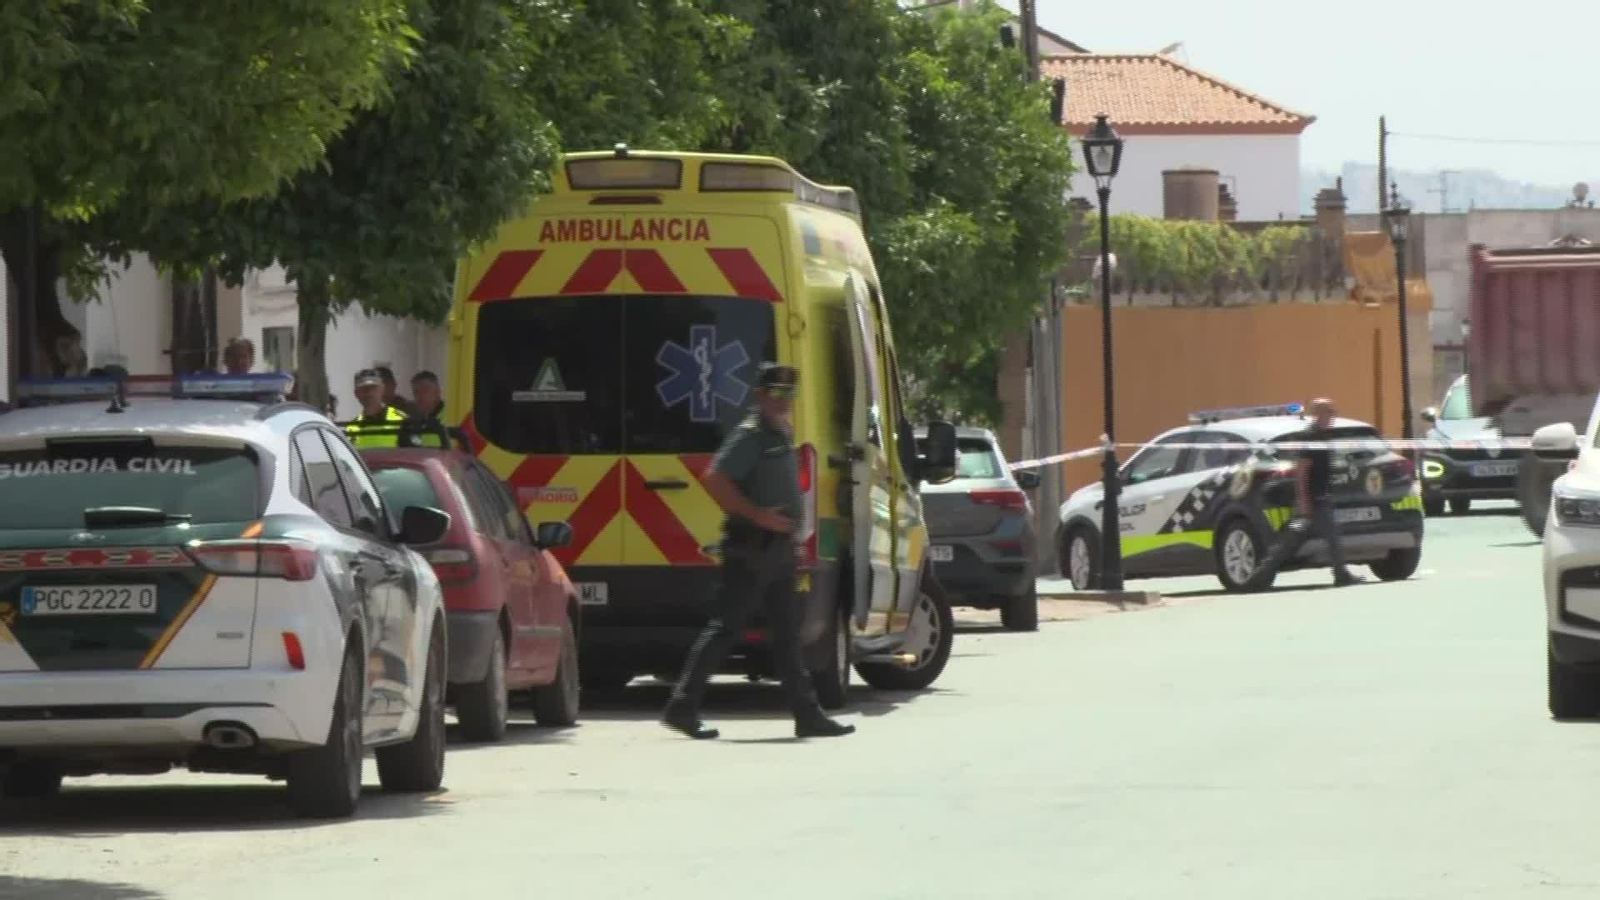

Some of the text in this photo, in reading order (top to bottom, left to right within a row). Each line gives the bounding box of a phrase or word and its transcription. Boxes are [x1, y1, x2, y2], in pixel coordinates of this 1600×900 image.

[539, 218, 710, 243] AMBULANCIA
[0, 457, 197, 479] GUARDIA CIVIL
[34, 589, 74, 610] PGC
[77, 588, 132, 610] 2222
[582, 585, 603, 601] ML
